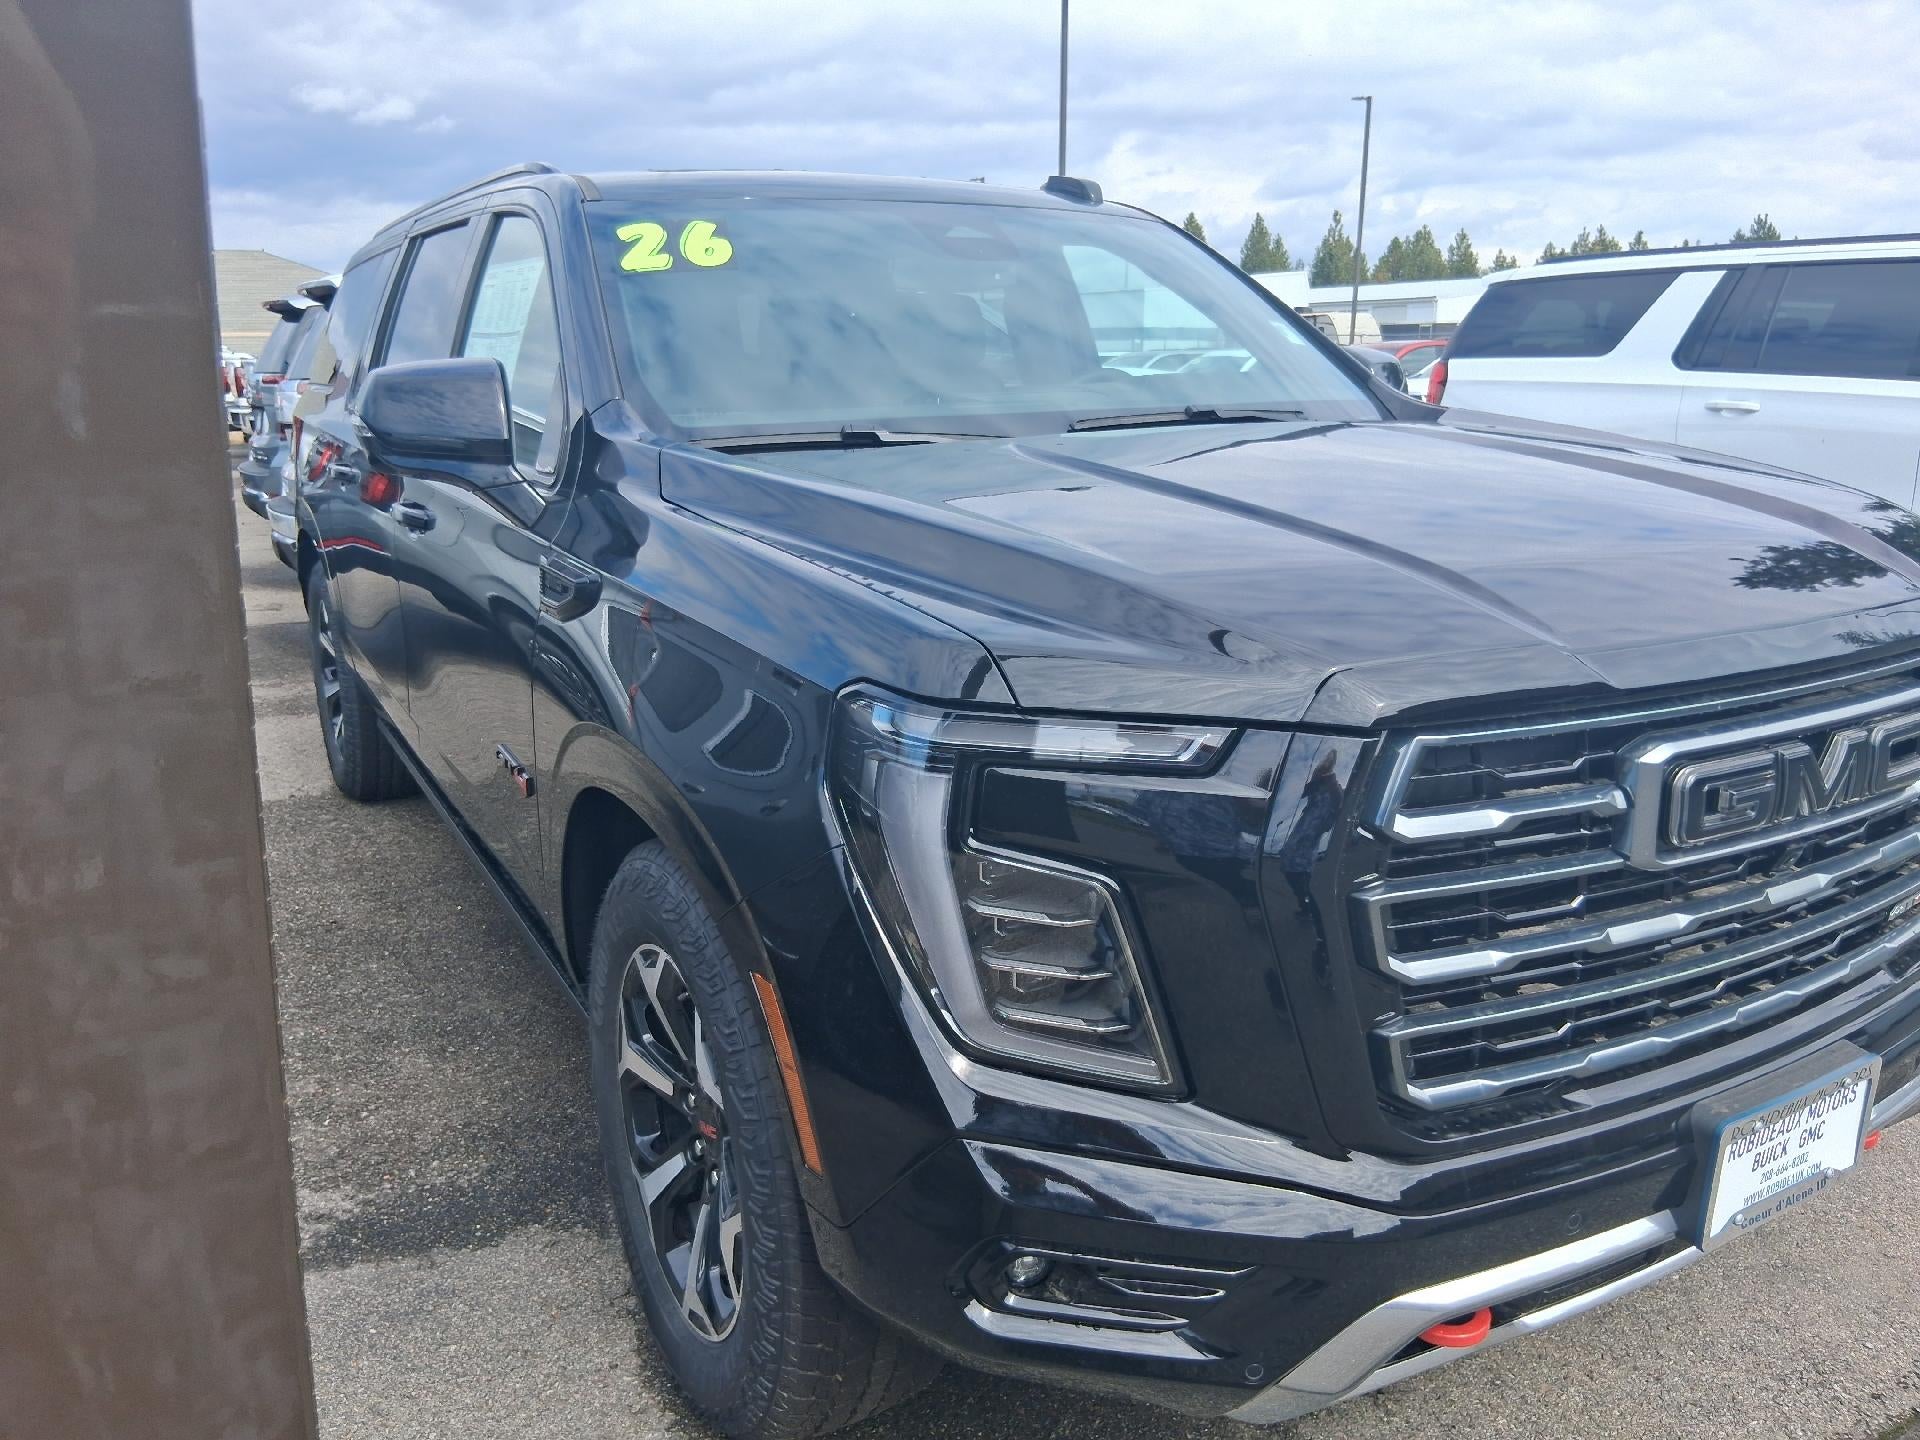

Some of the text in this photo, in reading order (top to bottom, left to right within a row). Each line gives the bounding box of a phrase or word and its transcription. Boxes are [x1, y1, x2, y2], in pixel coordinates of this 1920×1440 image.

[616, 220, 733, 272] 26
[1727, 1083, 1859, 1163] ROBIDEAUX MOTORS
[1751, 1120, 1826, 1172] BUICK GMC
[1775, 1187, 1814, 1212] d'Alene
